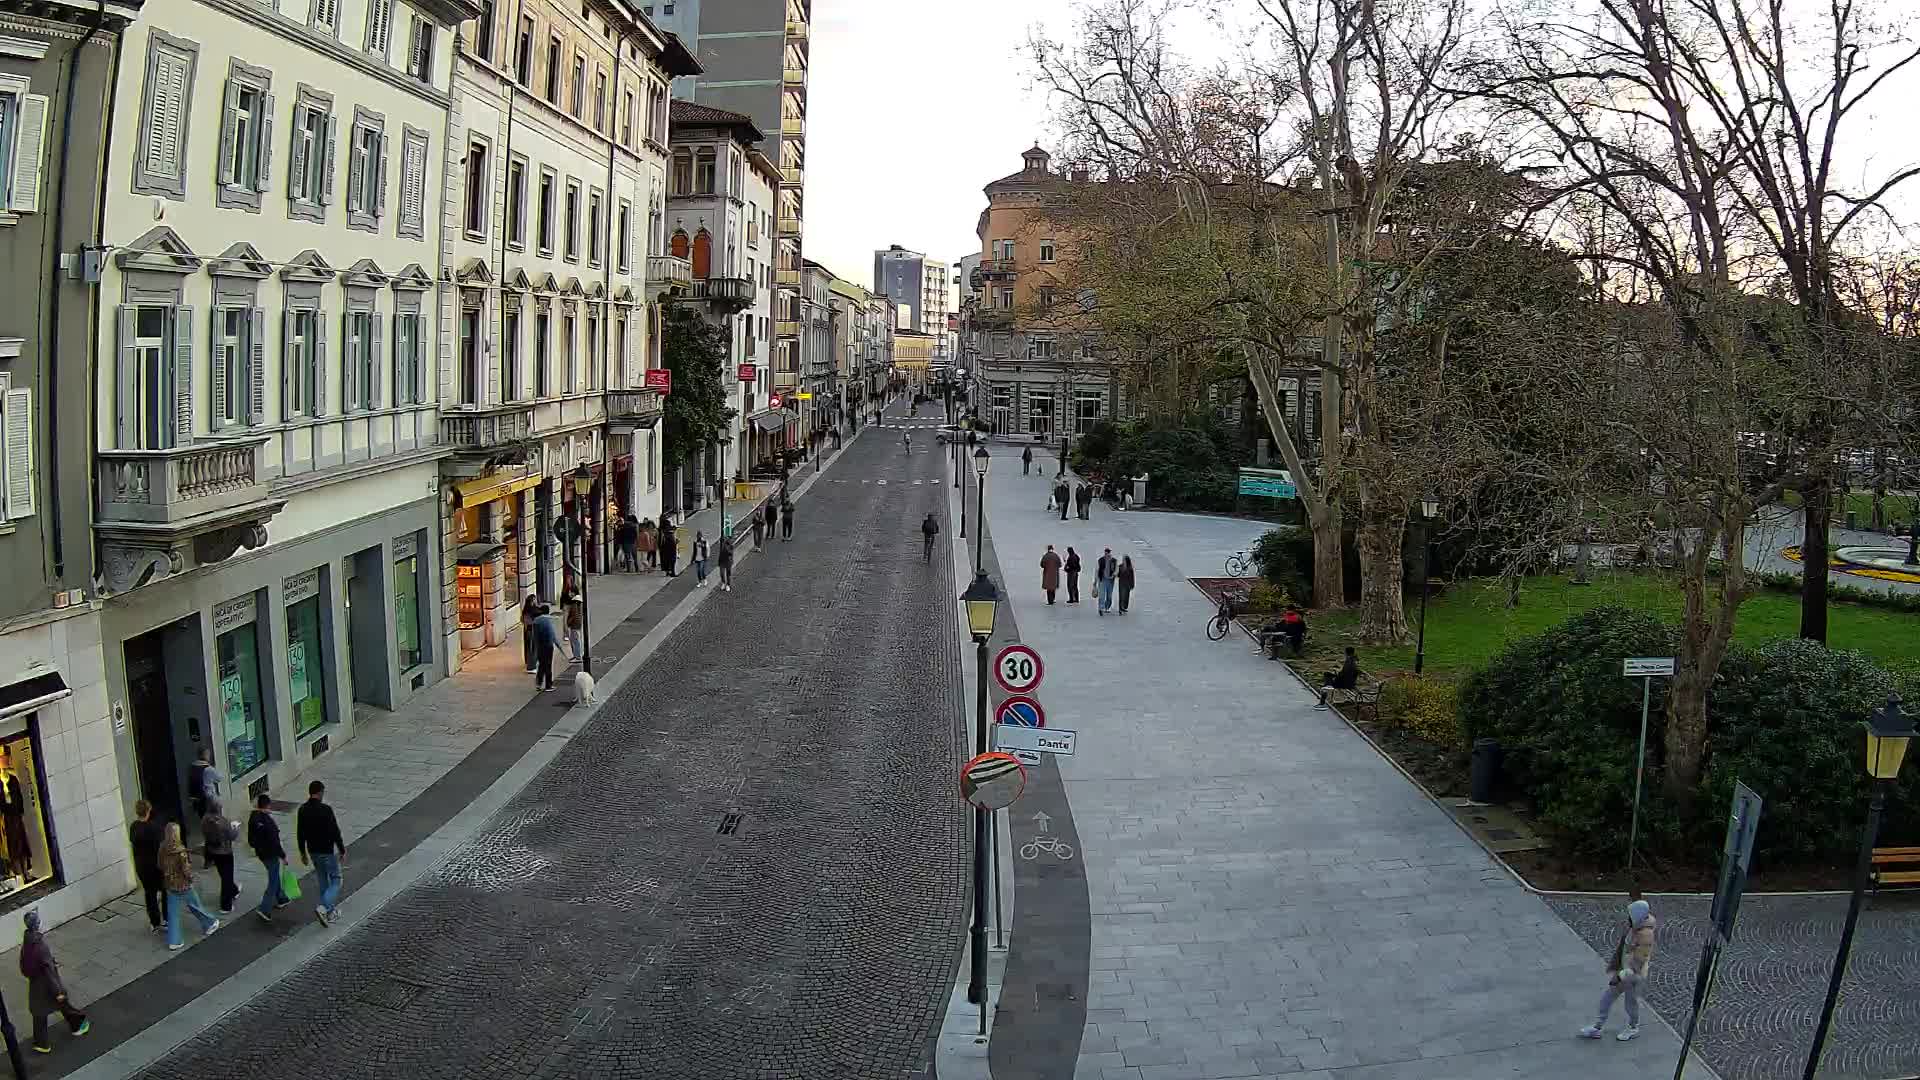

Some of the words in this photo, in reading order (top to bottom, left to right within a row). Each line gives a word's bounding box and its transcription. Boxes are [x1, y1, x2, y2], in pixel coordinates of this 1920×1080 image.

[1005, 657, 1033, 681] 30
[222, 677, 240, 701] 130
[1038, 738, 1070, 750] Dante
